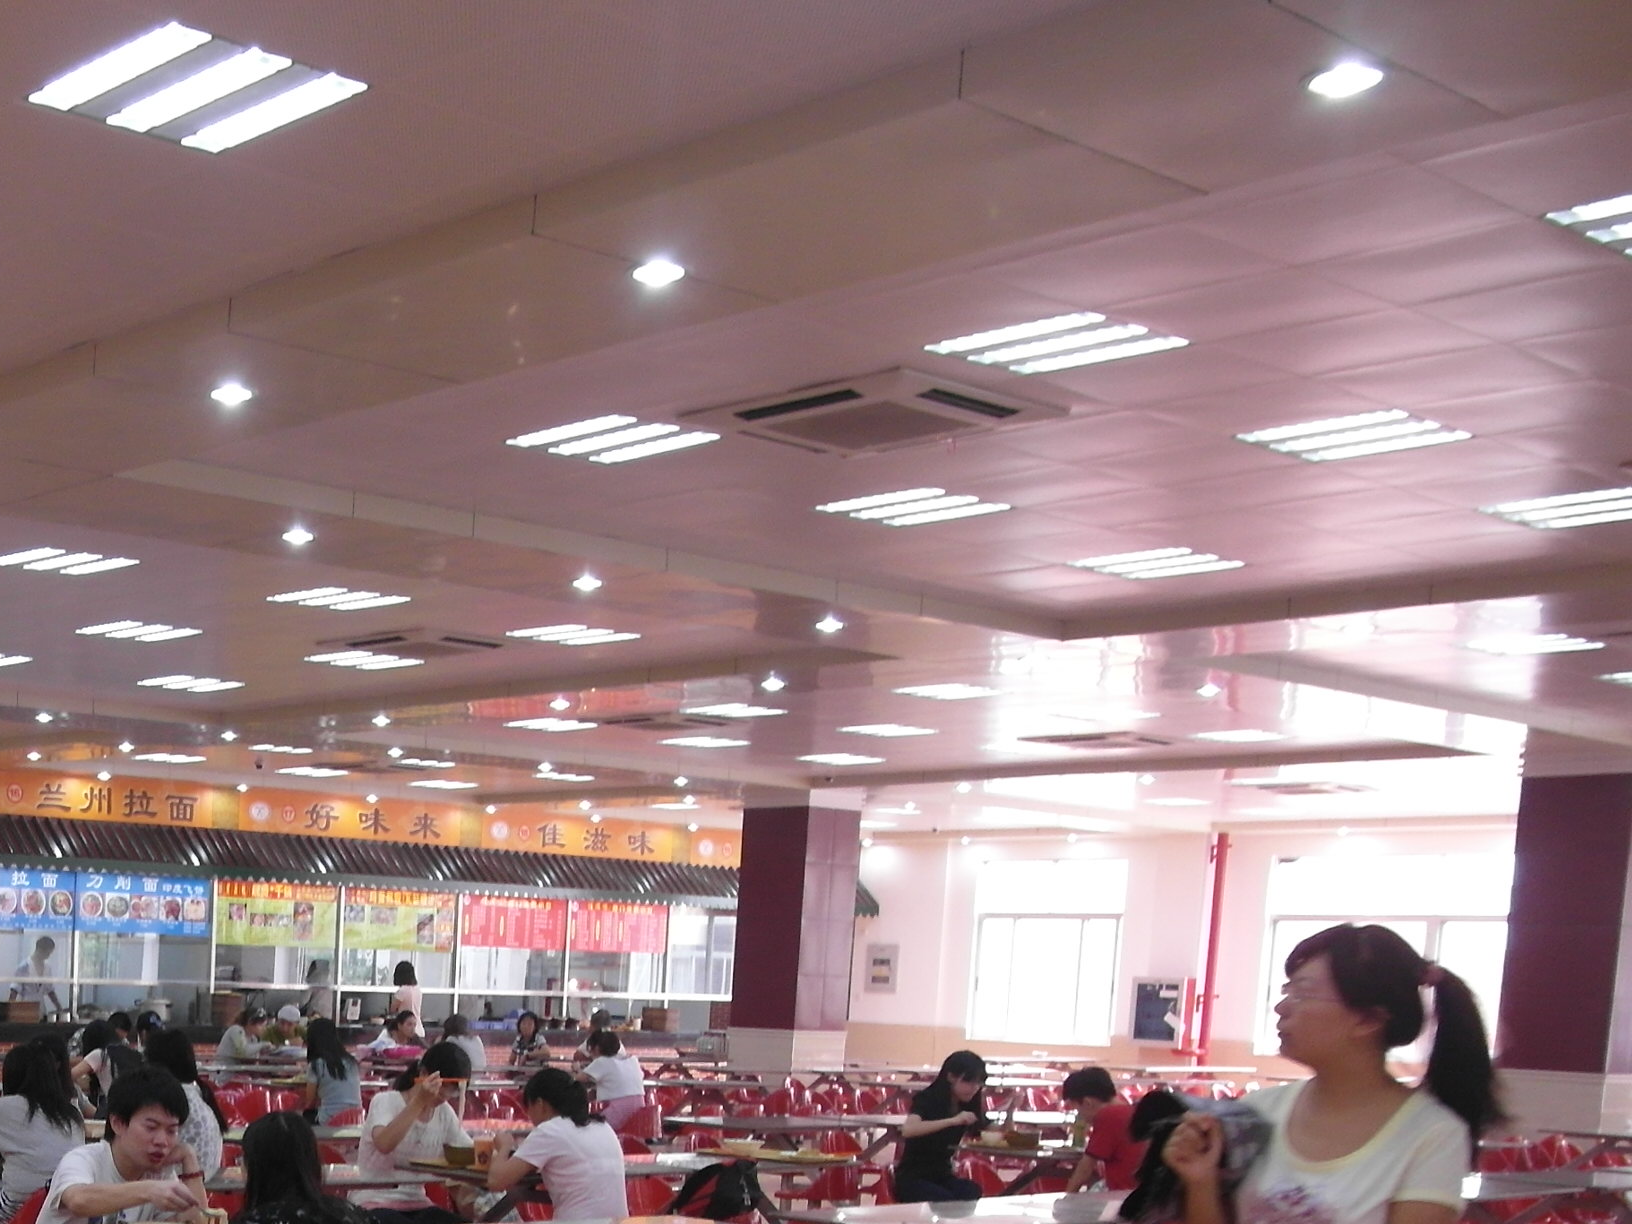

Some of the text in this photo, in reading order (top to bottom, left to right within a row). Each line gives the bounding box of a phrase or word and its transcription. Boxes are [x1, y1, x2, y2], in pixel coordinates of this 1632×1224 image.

[35, 782, 199, 823] 兰州拉面
[304, 802, 442, 840] 好味来
[536, 822, 656, 856] 佳滋味
[10, 869, 59, 889] 拉面
[85, 873, 160, 893] 刀削面
